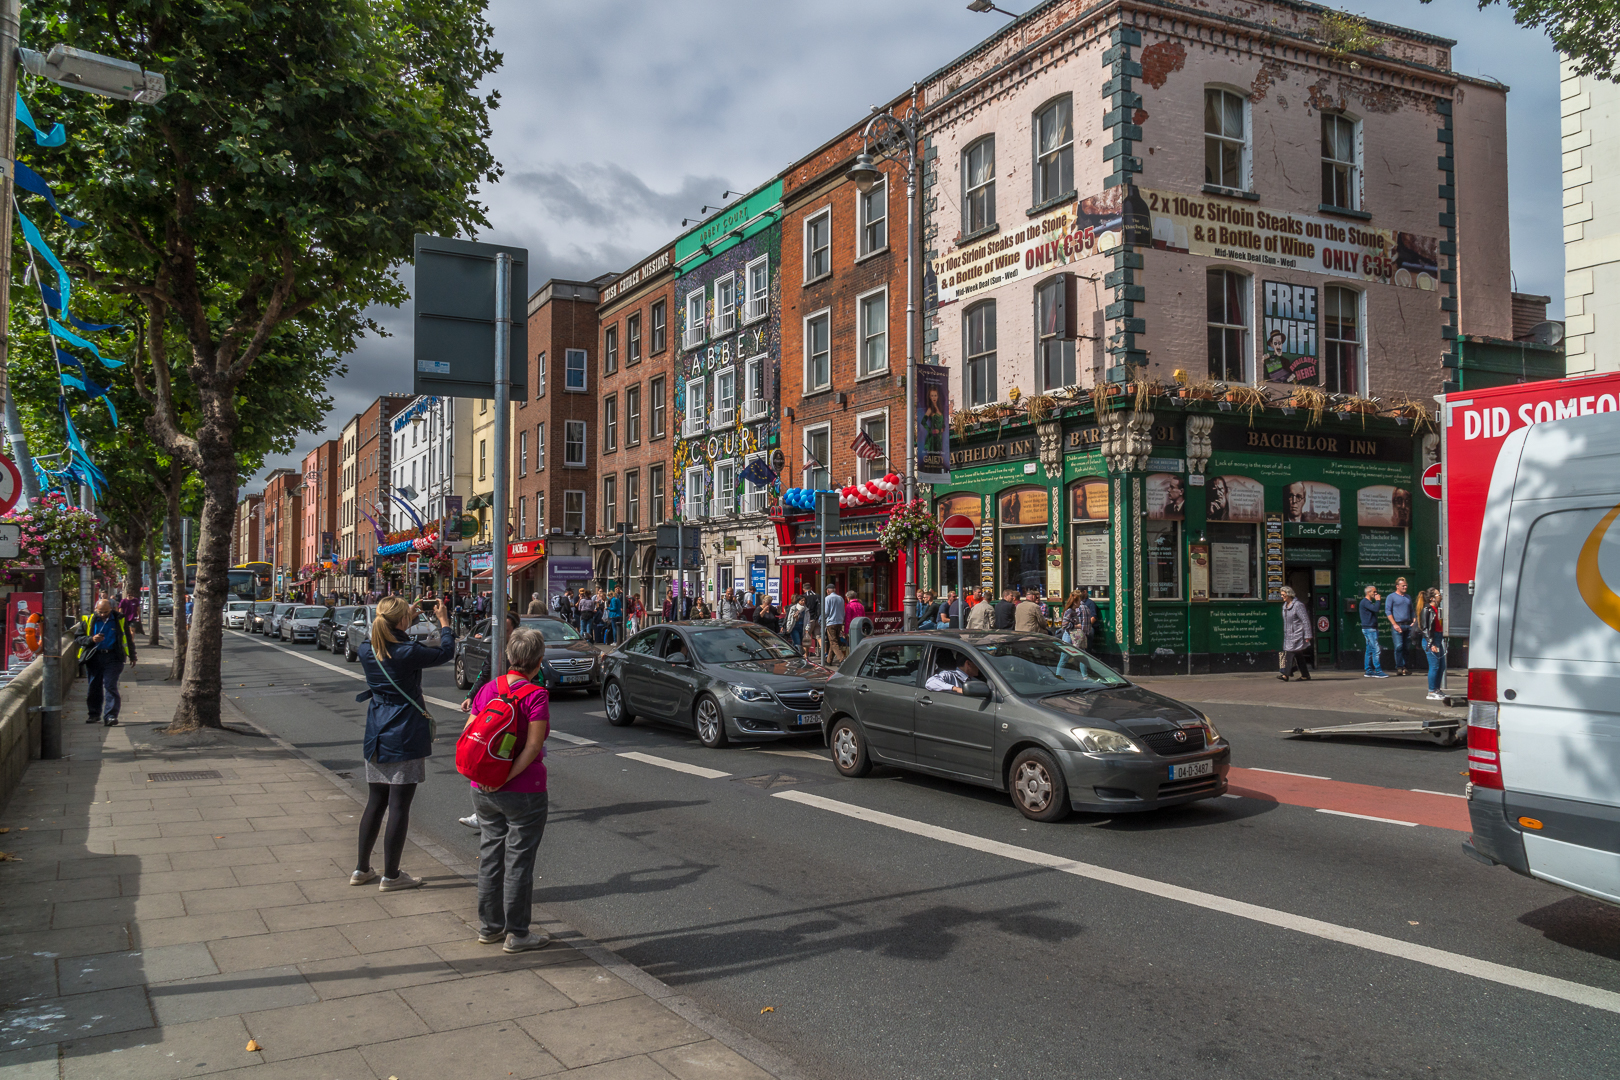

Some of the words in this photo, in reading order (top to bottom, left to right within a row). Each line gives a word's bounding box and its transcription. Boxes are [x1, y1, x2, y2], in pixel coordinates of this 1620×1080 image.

[700, 222, 720, 242] ABBEY
[723, 207, 748, 228] COURT
[1150, 193, 1157, 210] 2
[1161, 198, 1170, 212] x
[1172, 197, 1204, 218] 10oz
[1207, 203, 1254, 227] Sirloin
[1258, 210, 1302, 234] Steaks
[1306, 220, 1322, 238] on
[1325, 221, 1346, 242] the
[1348, 224, 1384, 248] Stone
[934, 261, 940, 275] 2
[940, 264, 945, 274] x
[946, 256, 961, 273] 10oz
[962, 246, 986, 266] Sirloin
[988, 234, 1014, 255] Steaks
[1015, 231, 1026, 245] on
[1026, 224, 1040, 242] the
[1042, 214, 1067, 236] Stone
[1025, 238, 1060, 271] ONLY
[1063, 226, 1095, 257] €35
[1194, 226, 1205, 242] &
[1208, 230, 1216, 243] a
[1220, 226, 1262, 251] Bottle
[1264, 234, 1278, 252] of
[1280, 236, 1315, 259] Wine
[1214, 248, 1246, 262] Mid-Week
[1247, 252, 1260, 263] Deal
[604, 283, 617, 303] IRISH
[620, 270, 640, 294] CHURCH
[642, 252, 669, 280] MISSIONS
[941, 277, 948, 290] &
[949, 276, 955, 287] a
[956, 264, 983, 285] Bottle
[984, 261, 994, 276] of
[995, 251, 1020, 272] Wine
[1322, 248, 1358, 272] ONLY
[1362, 254, 1393, 278] €35
[955, 282, 978, 298] Mid-Week
[979, 280, 990, 290] Deal
[1265, 282, 1316, 322] FREE
[692, 326, 764, 376] ABBEY
[1264, 317, 1316, 356] WiFi
[1290, 356, 1317, 372] AVAILABLE
[1295, 366, 1317, 381] HERE!
[1464, 407, 1510, 440] DID
[1518, 394, 1620, 428] SOMEO
[692, 424, 762, 462] COURT
[950, 444, 1006, 465] ACHELOR
[1010, 439, 1034, 455] INN
[1070, 428, 1100, 447] BAR
[1247, 432, 1337, 452] BACHELOR
[1349, 439, 1376, 455] INN
[923, 455, 944, 464] GAIETY
[1298, 524, 1316, 535] Poets
[1318, 525, 1340, 535] Corner
